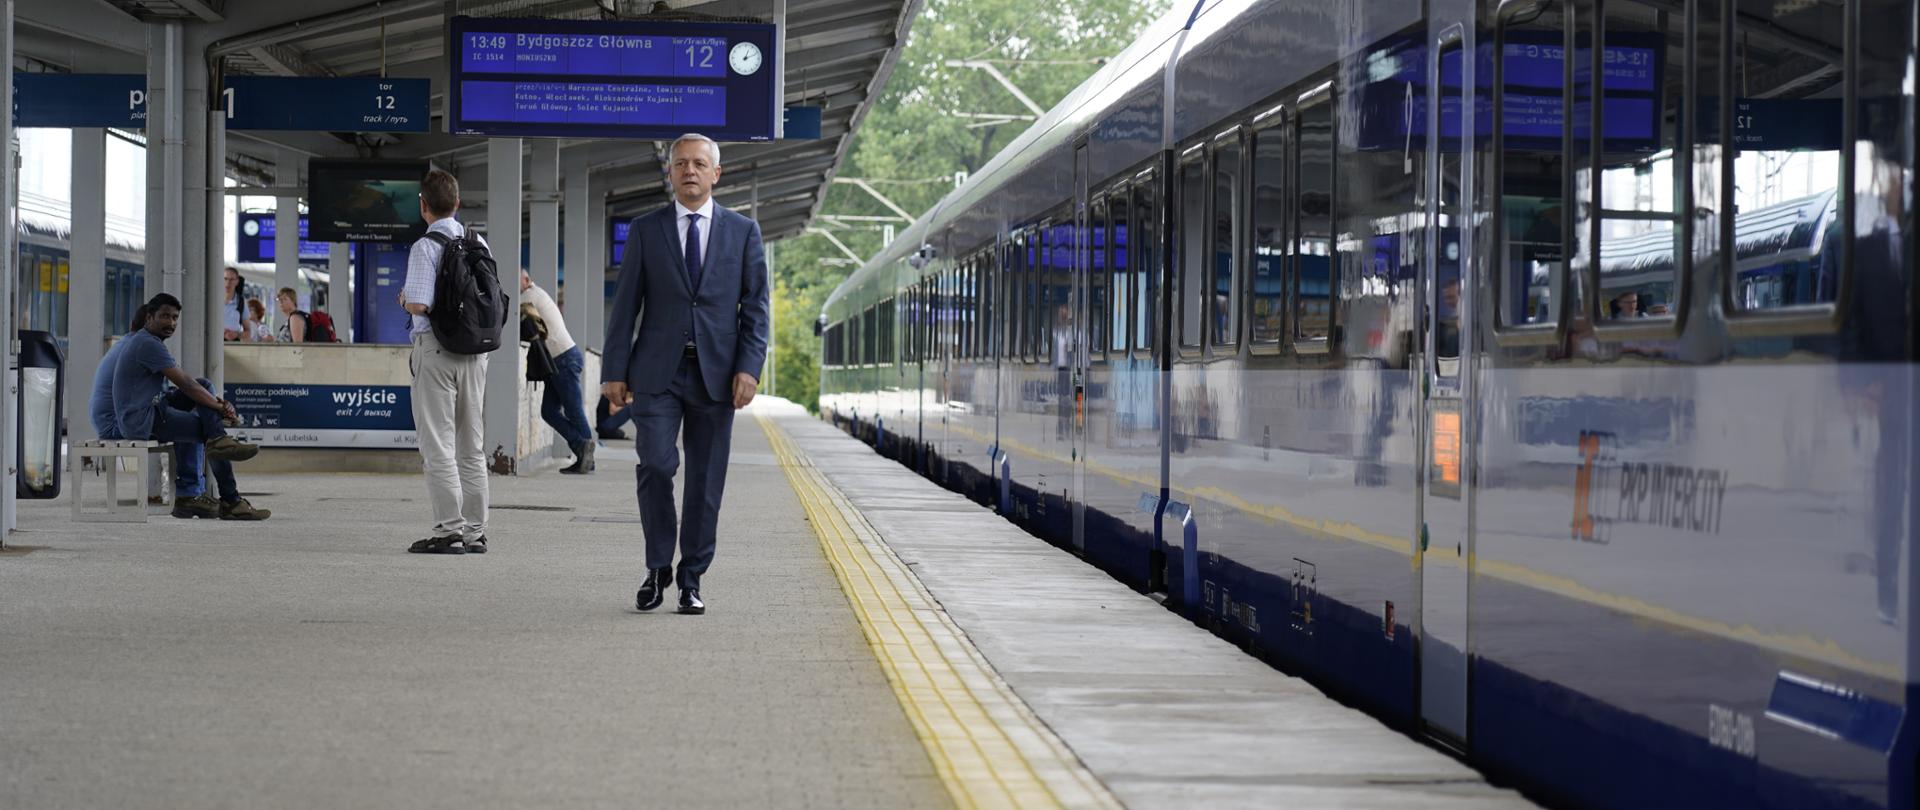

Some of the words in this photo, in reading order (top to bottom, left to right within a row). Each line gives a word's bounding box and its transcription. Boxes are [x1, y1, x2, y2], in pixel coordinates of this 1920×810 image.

[471, 35, 507, 49] 13:49
[517, 33, 593, 49] Bydgoszcz
[599, 35, 653, 49] Główna
[685, 45, 714, 68] 12
[129, 89, 147, 110] p
[223, 87, 235, 119] 1
[375, 95, 395, 109] 12
[363, 114, 383, 123] track
[235, 387, 267, 396] dworzec
[268, 387, 310, 398] podmiejski
[332, 388, 397, 407] wyjście
[336, 408, 353, 416] exit
[364, 408, 392, 418] выход
[273, 432, 283, 441] ul.
[284, 432, 319, 442] Lubelska
[1618, 461, 1648, 523] PKP
[1648, 463, 1729, 536] INTERCITY
